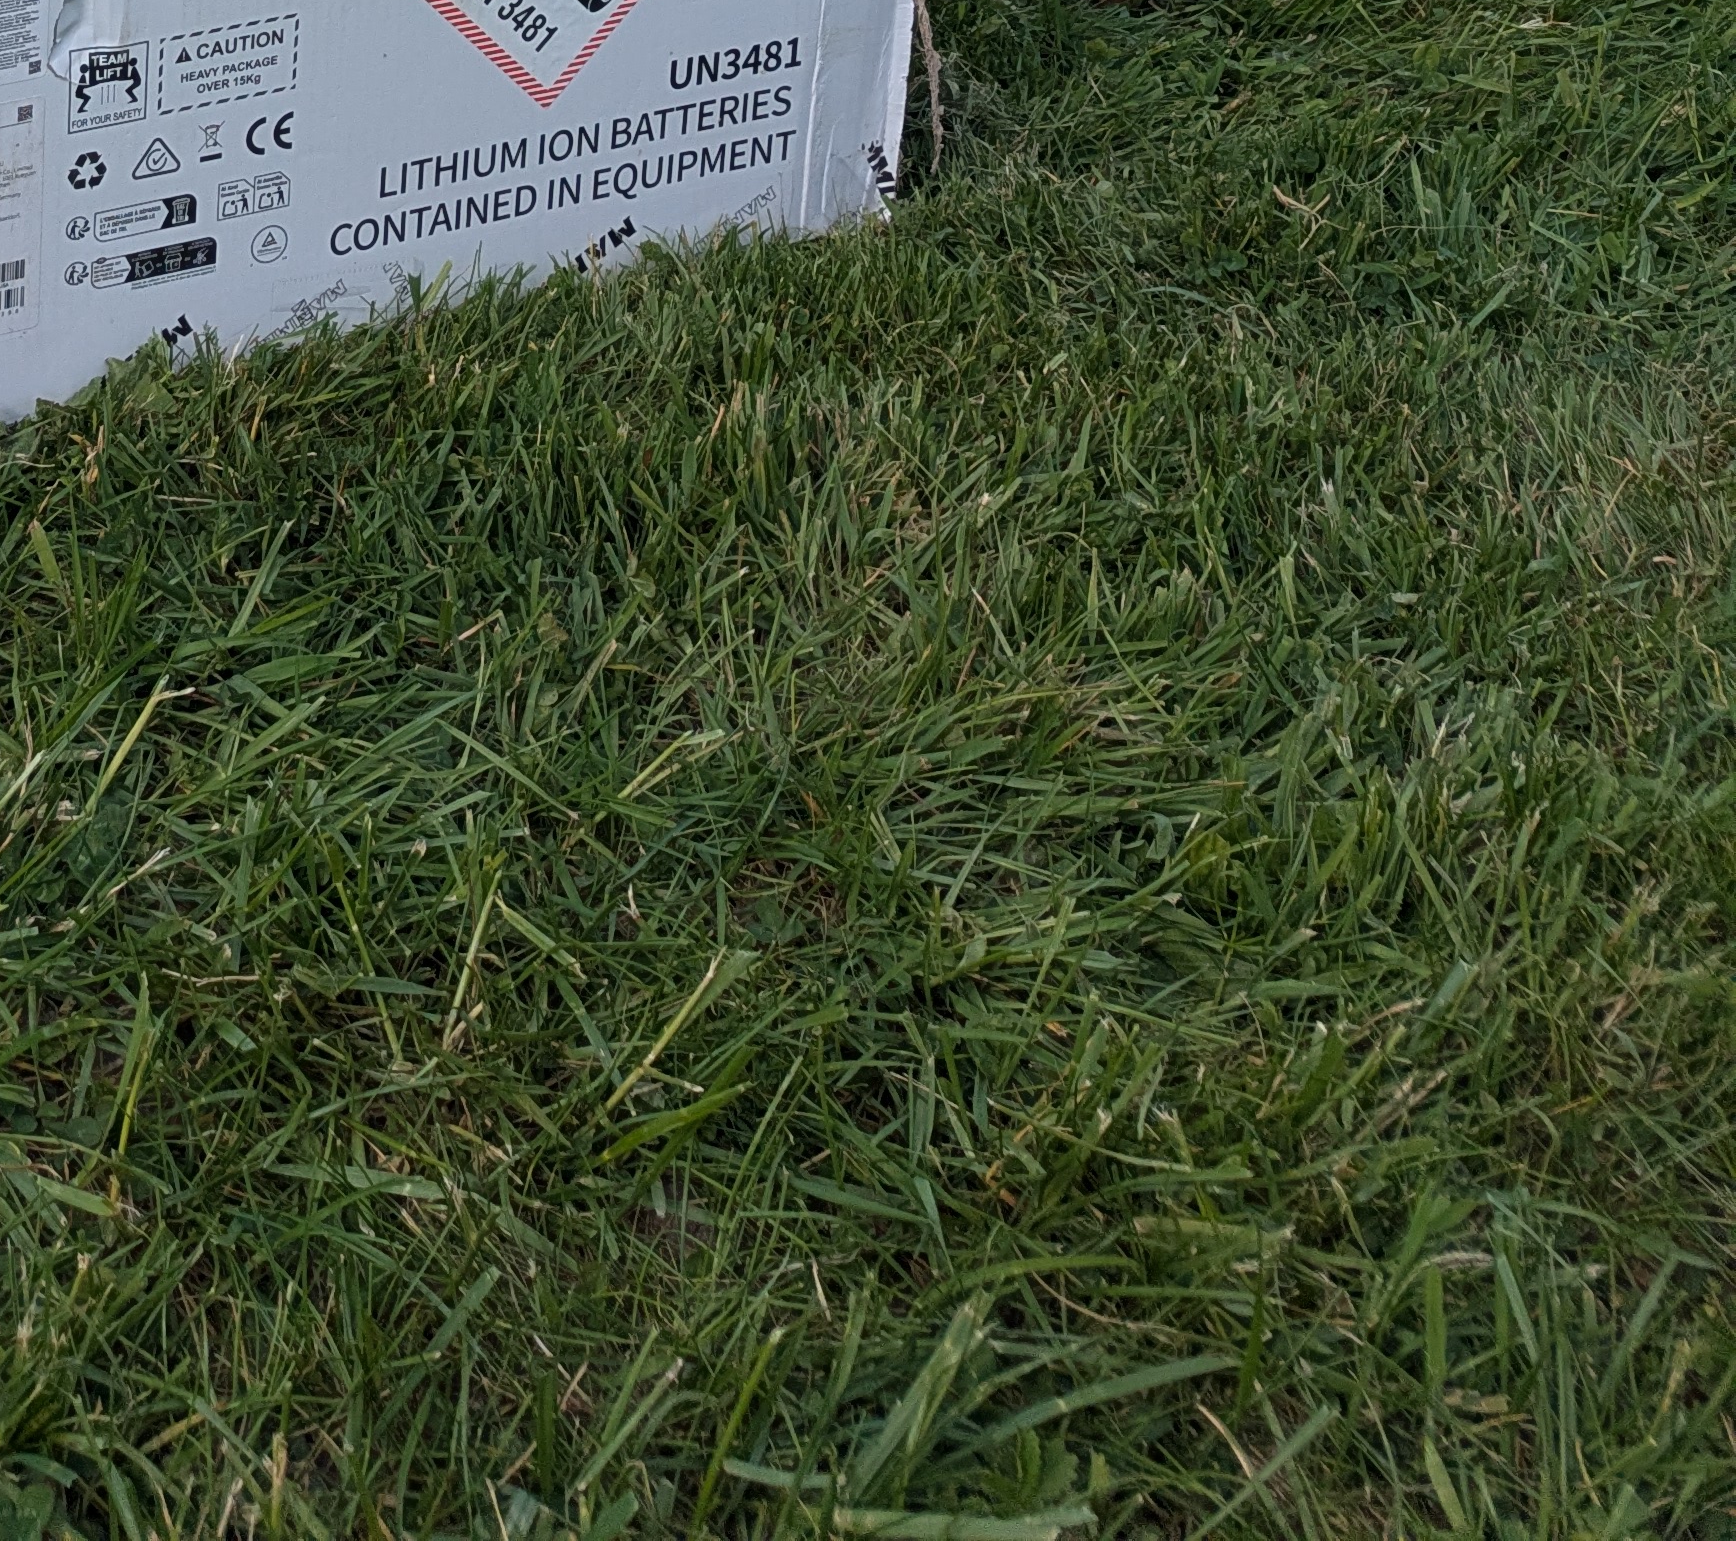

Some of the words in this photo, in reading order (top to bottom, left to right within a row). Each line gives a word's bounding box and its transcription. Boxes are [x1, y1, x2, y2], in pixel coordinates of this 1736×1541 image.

[196, 29, 285, 60] CAUTION
[91, 52, 128, 67] TEAM
[96, 66, 124, 81] LIFT
[180, 68, 219, 84] HEAVY
[222, 55, 279, 75] PACKAGE
[669, 37, 803, 90] UN3481
[197, 80, 231, 94] OVER
[233, 74, 262, 89] 15Kg
[71, 118, 88, 129] FOR
[89, 113, 112, 127] YOUR
[113, 108, 143, 123] SAFETY
[379, 137, 529, 199] LITHIUM
[536, 122, 601, 169] ION
[610, 85, 793, 150] BATTERIES
[329, 183, 538, 256] CONTAINED
[545, 174, 583, 213] IN
[591, 129, 797, 201] EQUIPMENT
